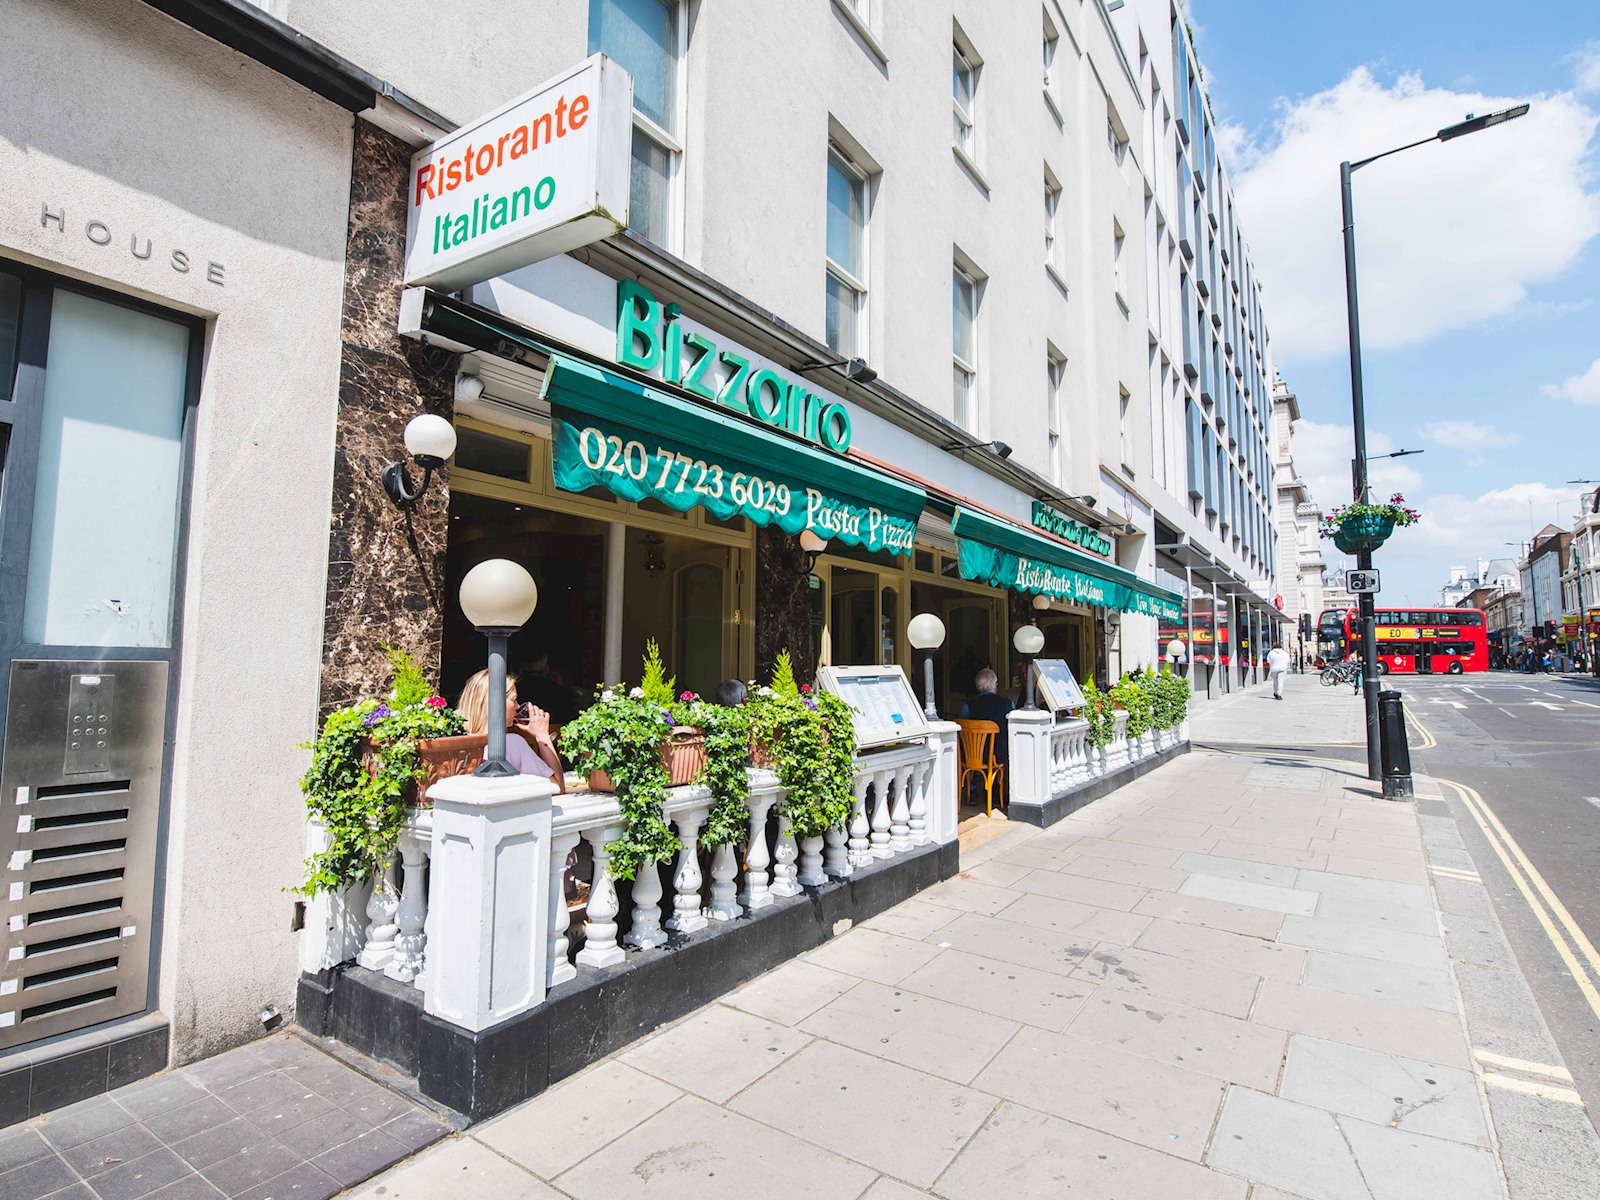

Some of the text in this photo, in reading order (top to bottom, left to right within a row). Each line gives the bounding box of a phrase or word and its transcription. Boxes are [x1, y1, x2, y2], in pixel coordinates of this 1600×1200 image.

[415, 94, 590, 207] Ristorante
[40, 201, 226, 288] HOUSE
[433, 176, 556, 255] Italiano
[616, 278, 852, 454] Bizzarro
[579, 426, 914, 550] 020 7723 6029 Pasta Pizza
